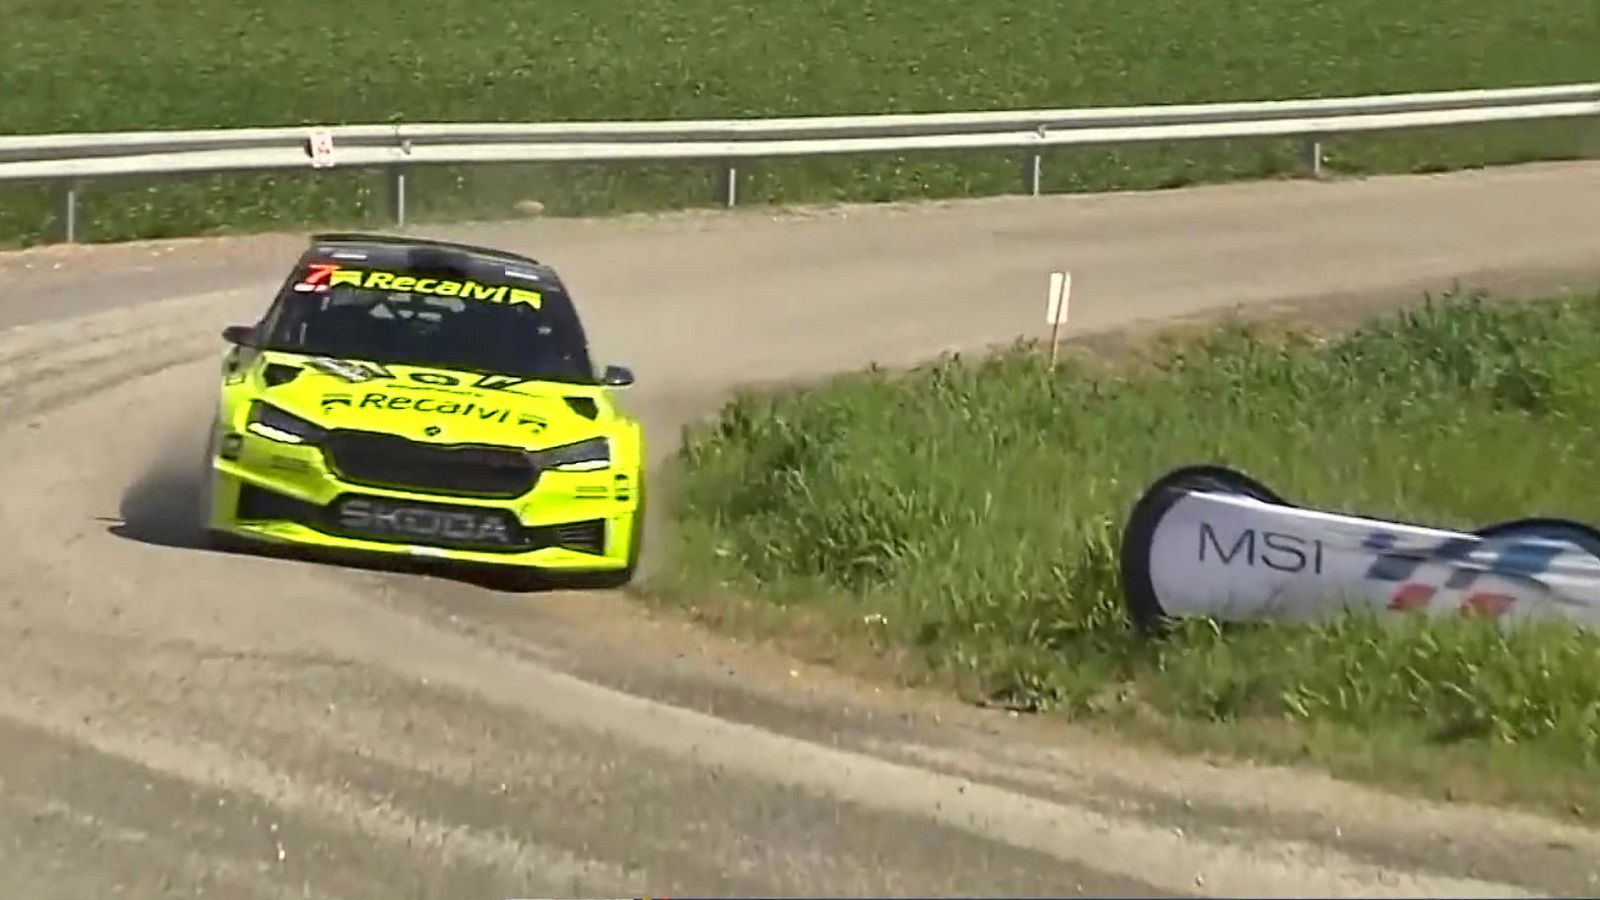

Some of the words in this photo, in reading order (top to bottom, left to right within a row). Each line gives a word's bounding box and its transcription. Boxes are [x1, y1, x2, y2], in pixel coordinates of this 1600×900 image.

[363, 270, 509, 304] Recalvi
[359, 392, 512, 424] Recalvi
[1198, 521, 1324, 575] MSI
